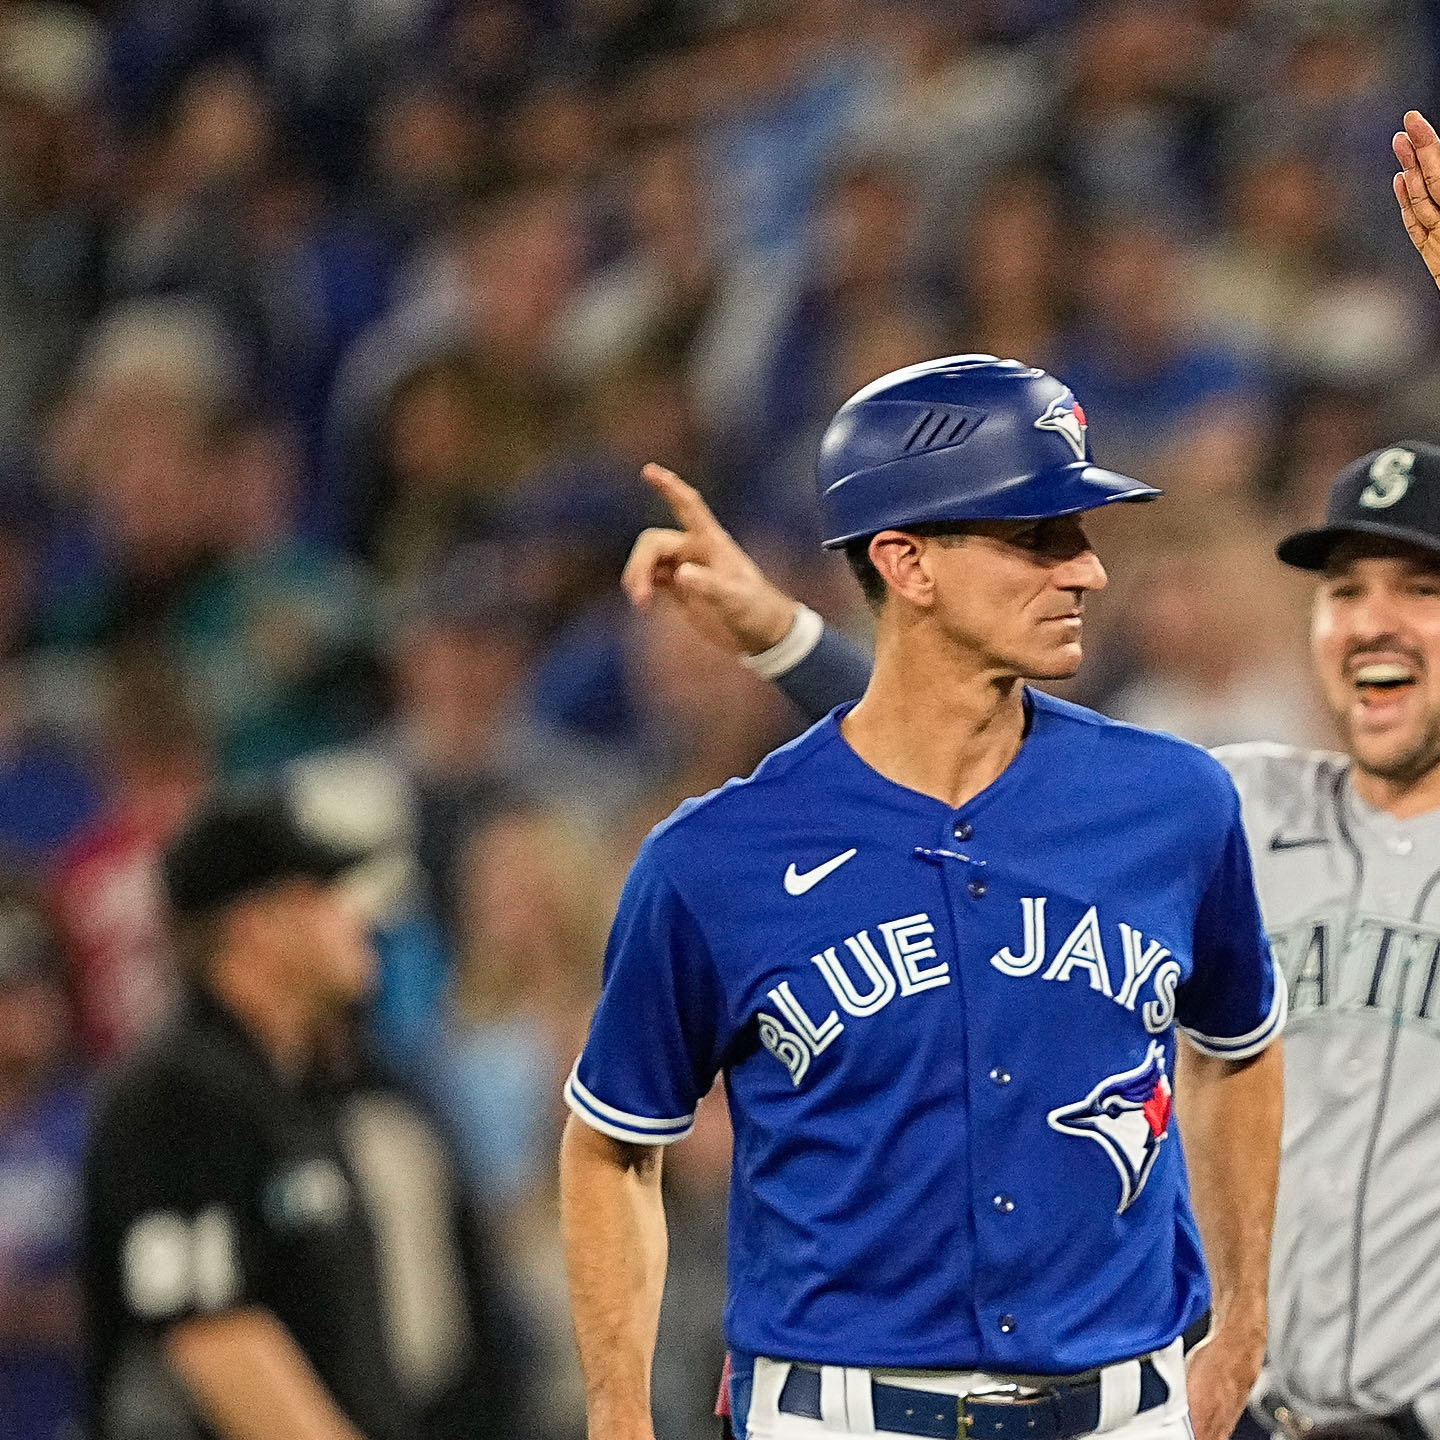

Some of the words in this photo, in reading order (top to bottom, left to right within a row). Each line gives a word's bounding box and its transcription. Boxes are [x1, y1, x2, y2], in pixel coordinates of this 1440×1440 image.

[1359, 448, 1416, 509] S
[758, 911, 952, 1087] BLUE
[990, 896, 1183, 1034] JAYS
